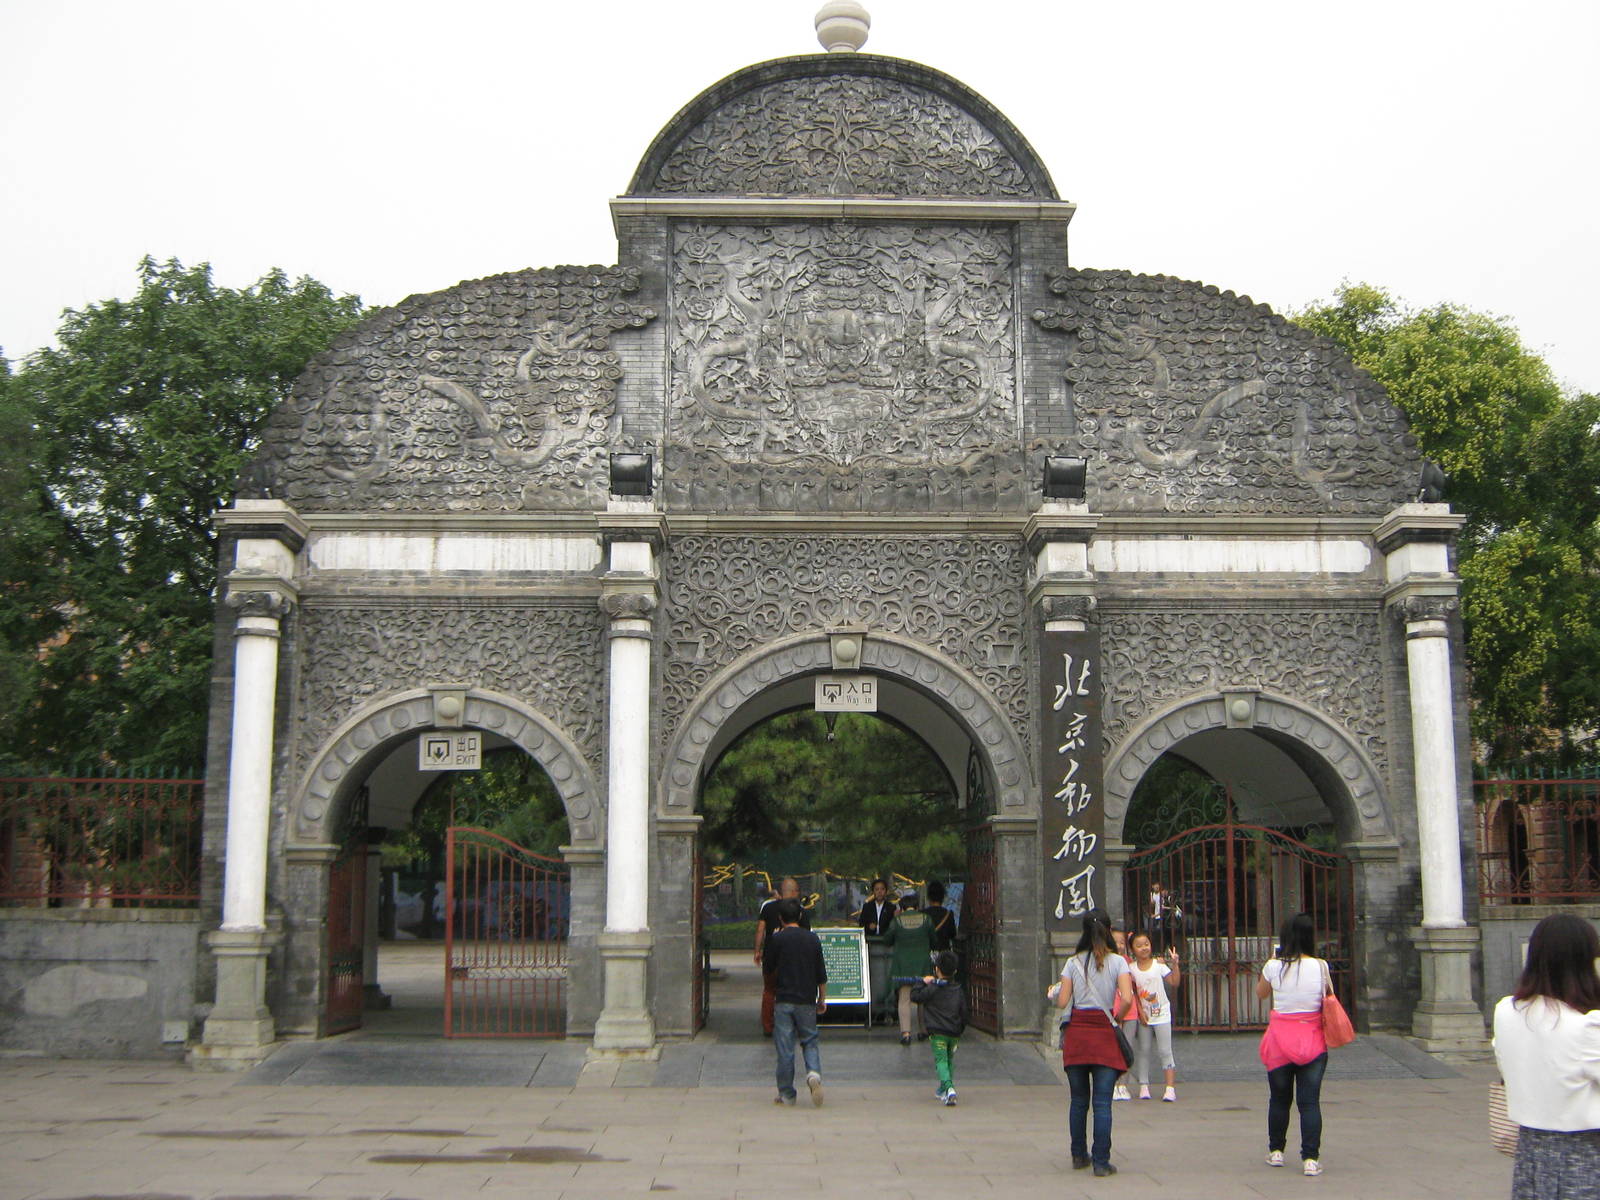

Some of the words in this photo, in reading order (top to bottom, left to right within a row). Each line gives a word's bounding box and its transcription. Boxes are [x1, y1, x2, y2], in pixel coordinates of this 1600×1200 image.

[847, 681, 872, 694] 入口
[456, 736, 477, 751] 出口
[456, 754, 477, 765] EXIT
